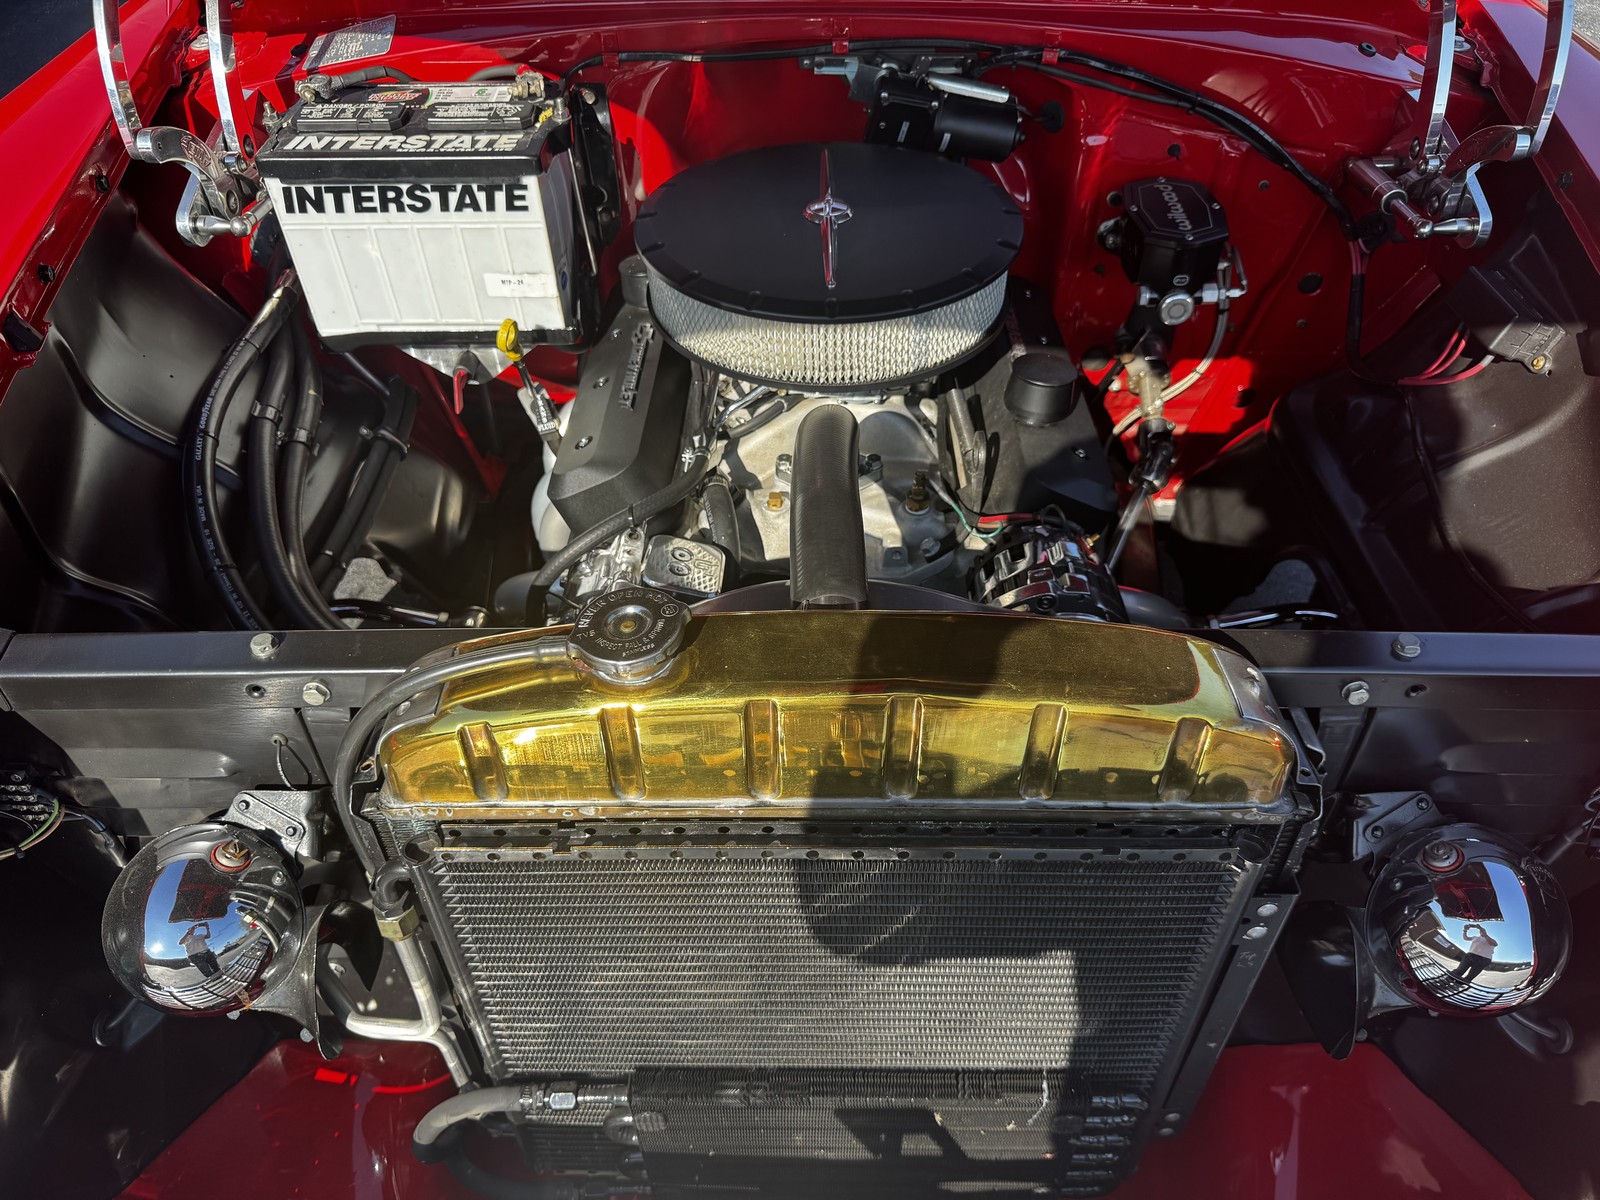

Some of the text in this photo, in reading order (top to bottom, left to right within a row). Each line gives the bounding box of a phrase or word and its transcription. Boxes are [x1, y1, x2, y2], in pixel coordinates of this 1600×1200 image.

[282, 134, 525, 151] INTERSTATE
[282, 184, 530, 215] INTERSTATE
[1153, 184, 1193, 231] wilwood
[195, 436, 203, 460] GALAXY
[199, 396, 213, 429] GOODYEAR
[198, 506, 207, 522] MADE
[578, 590, 668, 628] NEVER OPEN HOT
[594, 637, 623, 651] INSPECT
